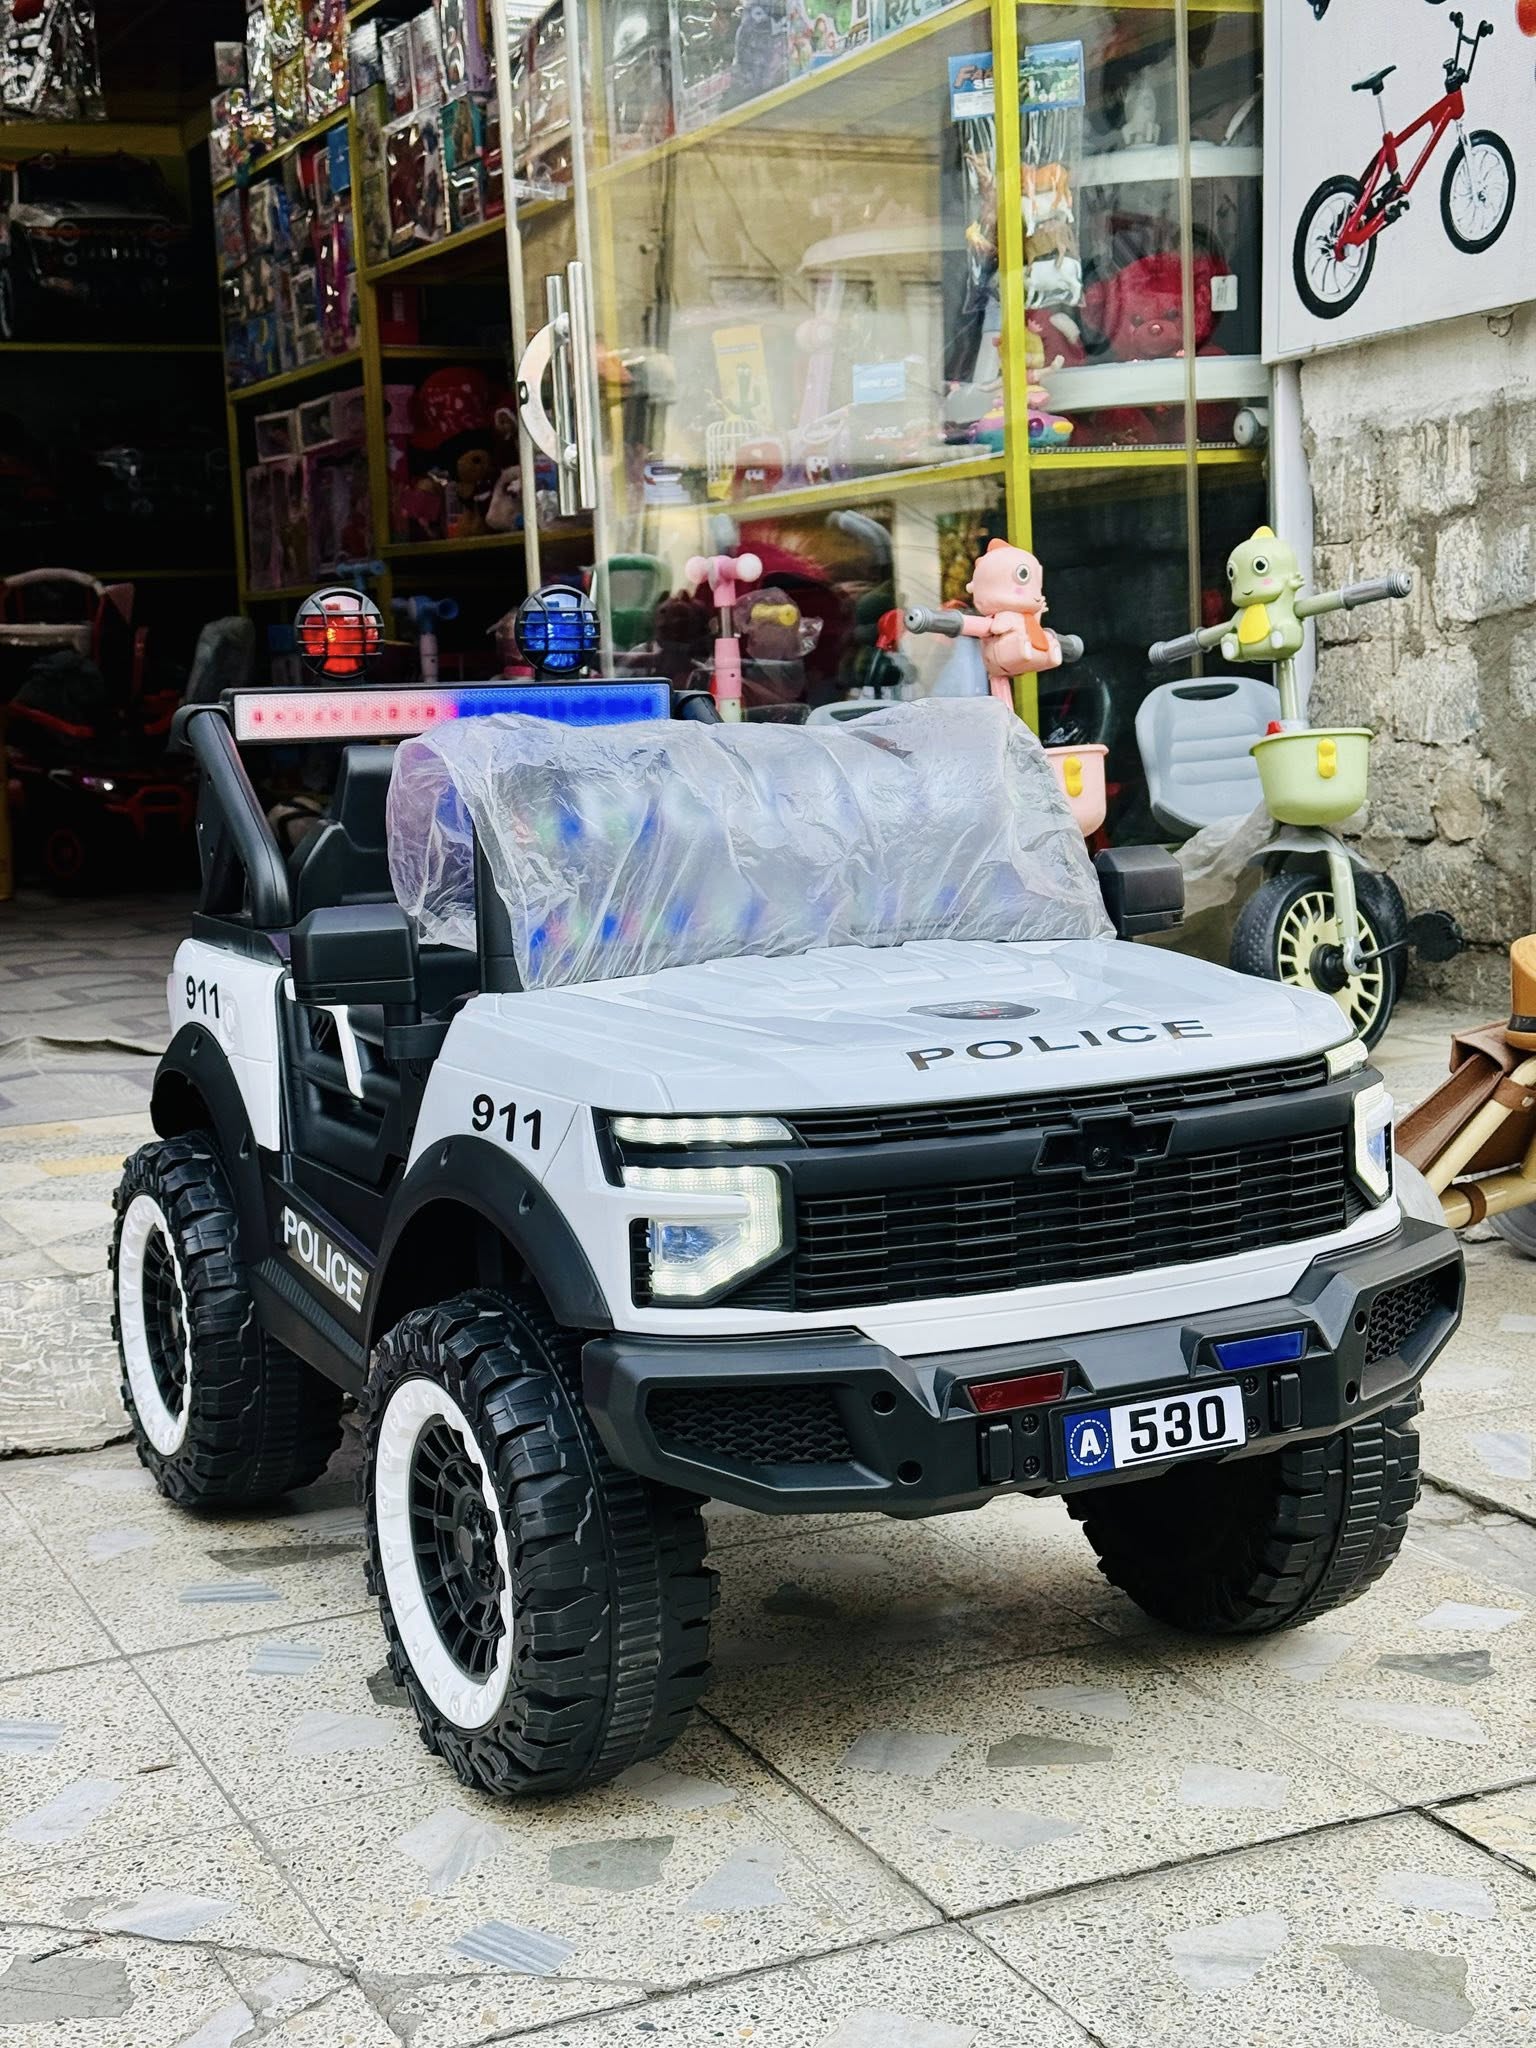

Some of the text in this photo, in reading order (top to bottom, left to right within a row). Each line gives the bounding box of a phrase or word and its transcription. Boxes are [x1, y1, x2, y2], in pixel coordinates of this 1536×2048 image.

[186, 975, 219, 1019] 911
[906, 1020, 1212, 1071] POLICE
[472, 1093, 541, 1151] 911
[284, 1205, 362, 1312] POLICE
[1080, 1395, 1226, 1458] A 530
